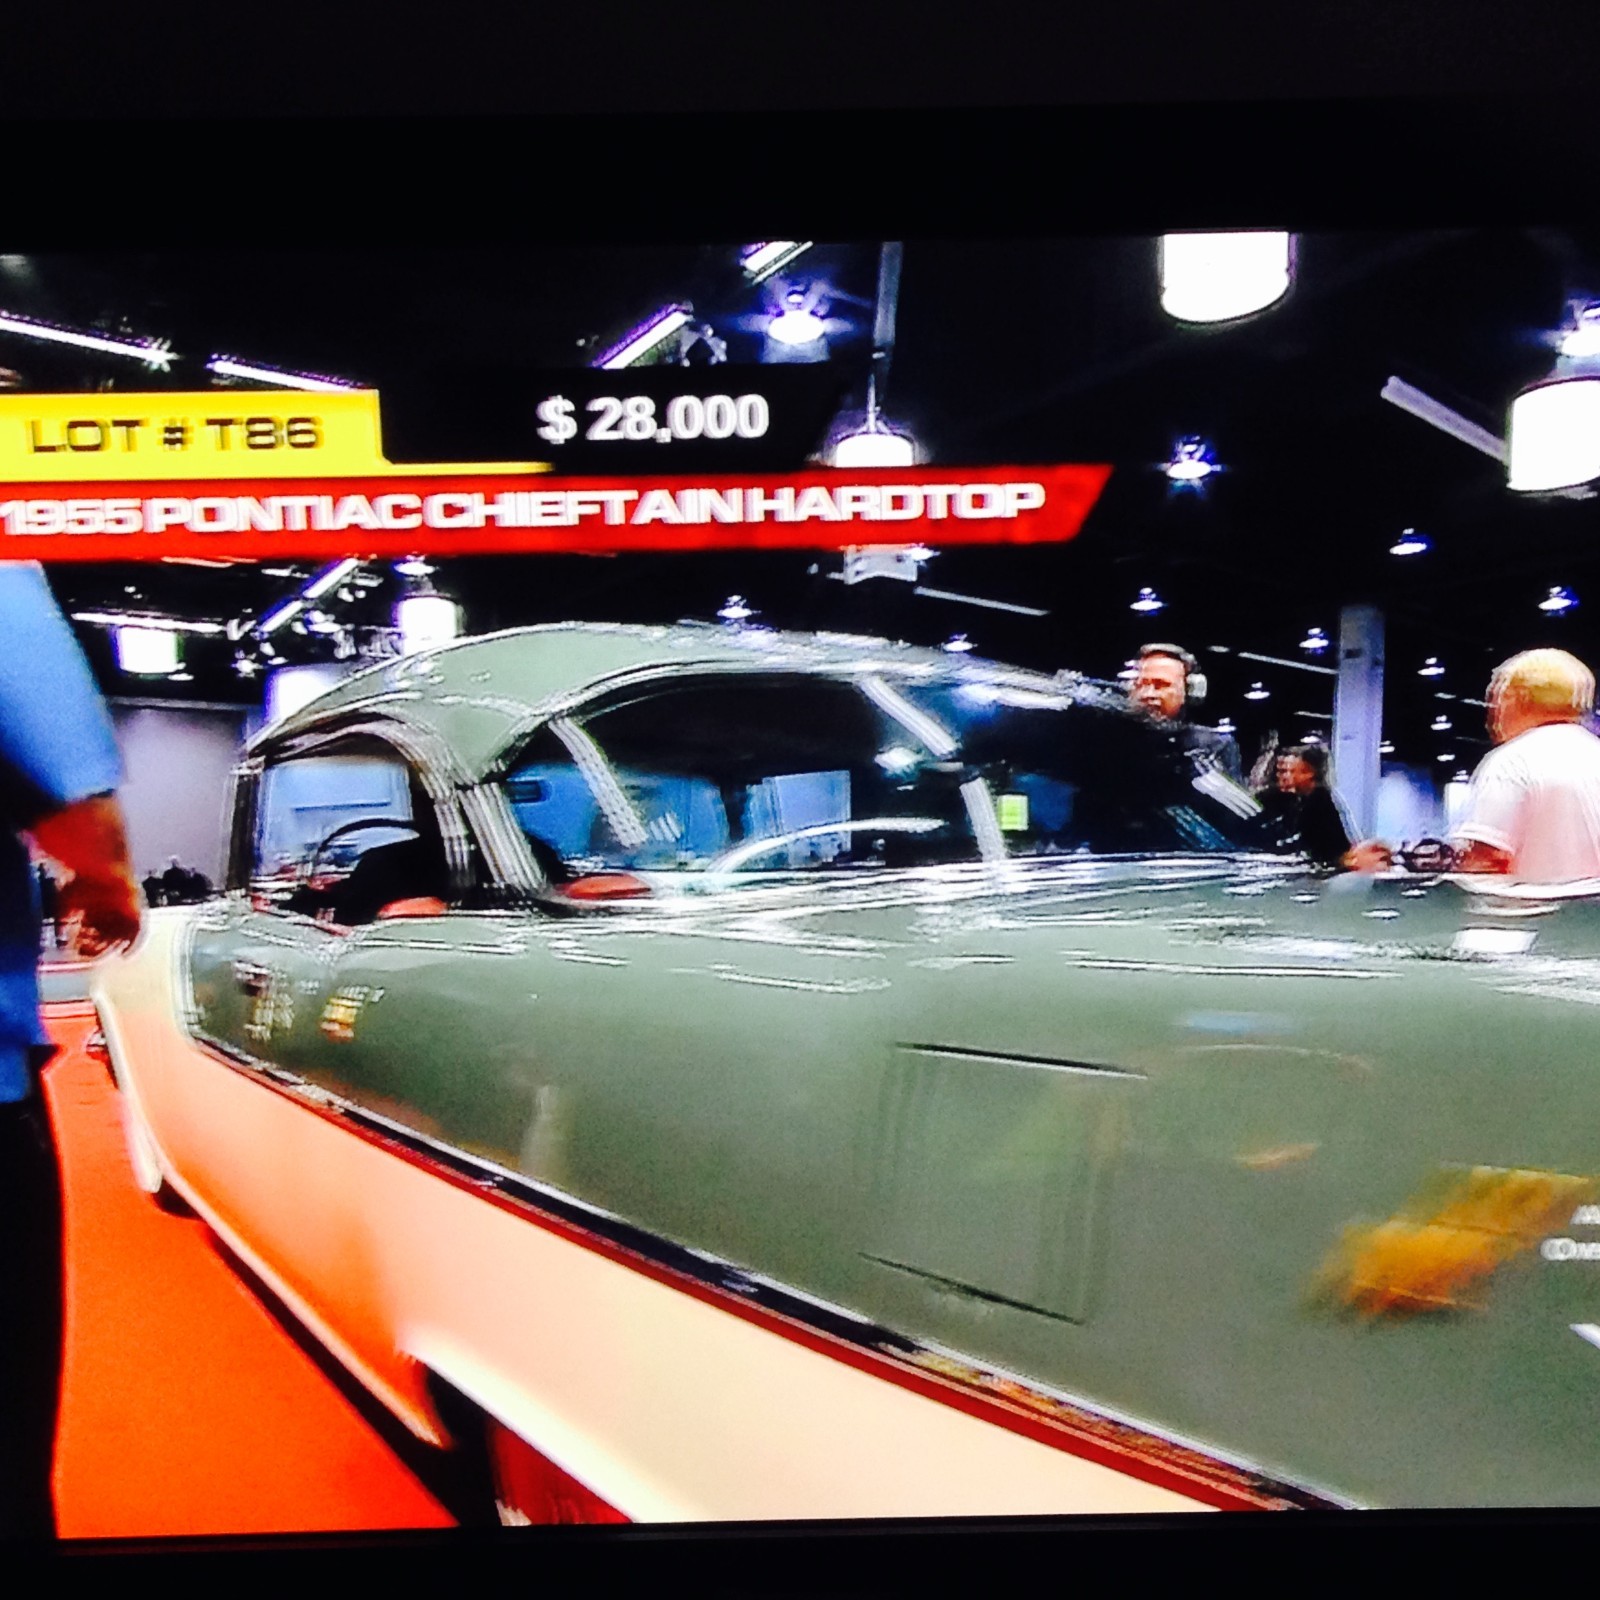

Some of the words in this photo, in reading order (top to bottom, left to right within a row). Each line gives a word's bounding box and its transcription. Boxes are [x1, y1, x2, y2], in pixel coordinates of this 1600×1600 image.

[29, 419, 145, 453] LOT
[162, 419, 191, 450] #
[206, 416, 321, 449] T86
[537, 396, 577, 444] $
[585, 394, 769, 443] 28,000
[0, 499, 143, 534] 1955
[144, 495, 422, 533] PONTIAC
[424, 487, 744, 529] CHIEFTAIN
[745, 483, 1046, 522] HARDTOP
